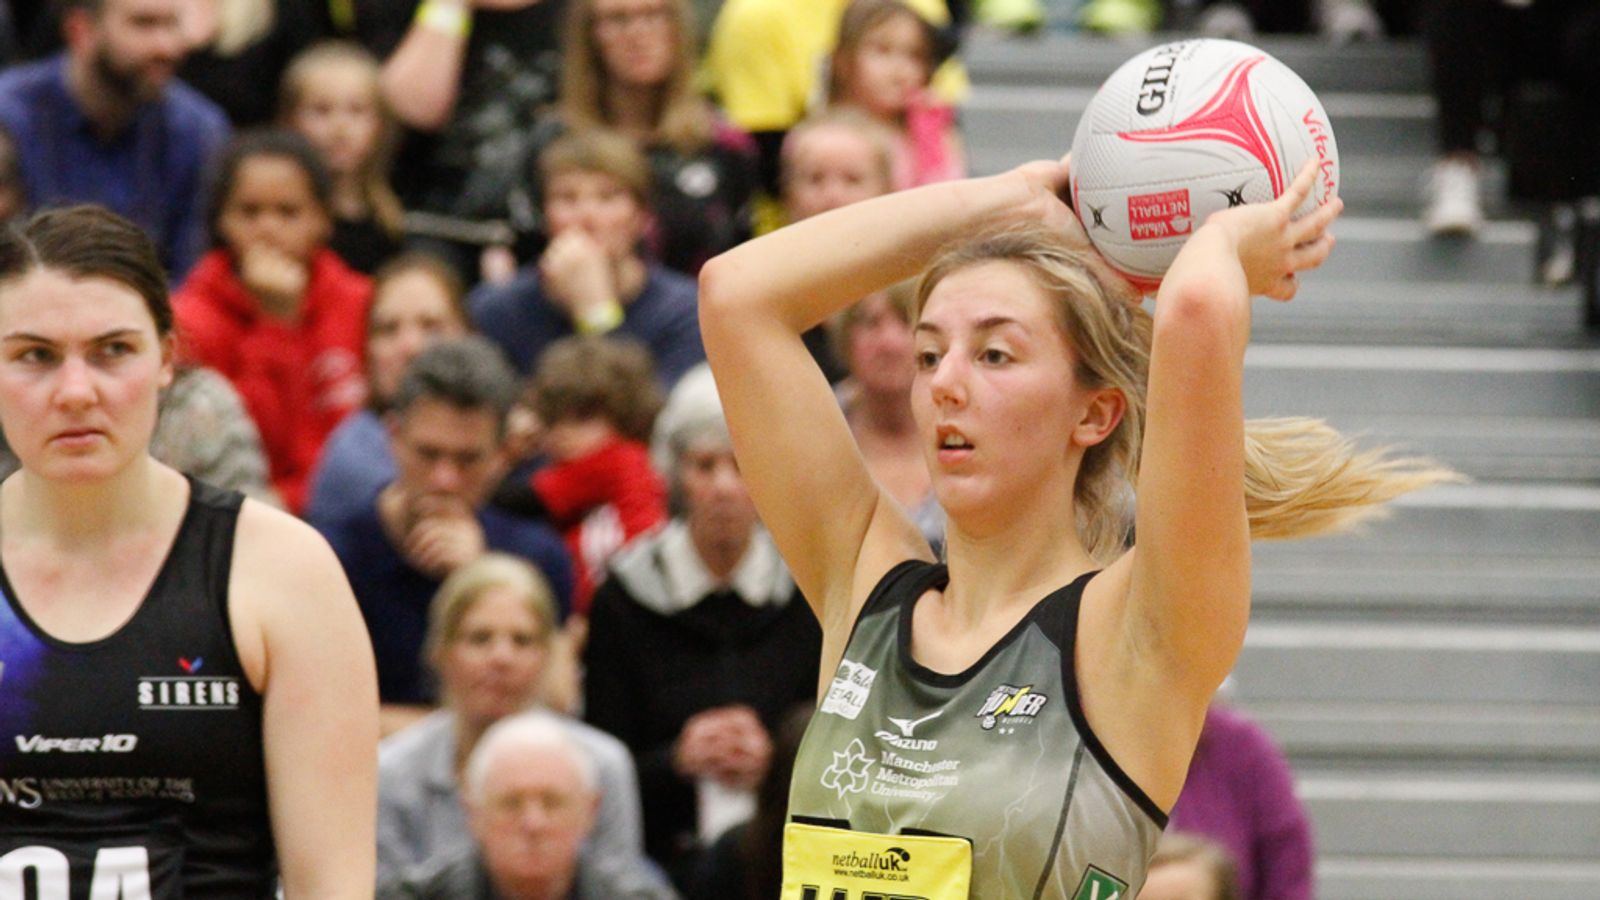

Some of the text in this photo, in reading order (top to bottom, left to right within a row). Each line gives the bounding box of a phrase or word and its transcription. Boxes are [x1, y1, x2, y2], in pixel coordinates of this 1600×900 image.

[1130, 200, 1188, 219] NETBALL
[137, 681, 240, 705] SIRENS
[881, 751, 961, 773] Manchester
[876, 767, 959, 790] Metropolitan
